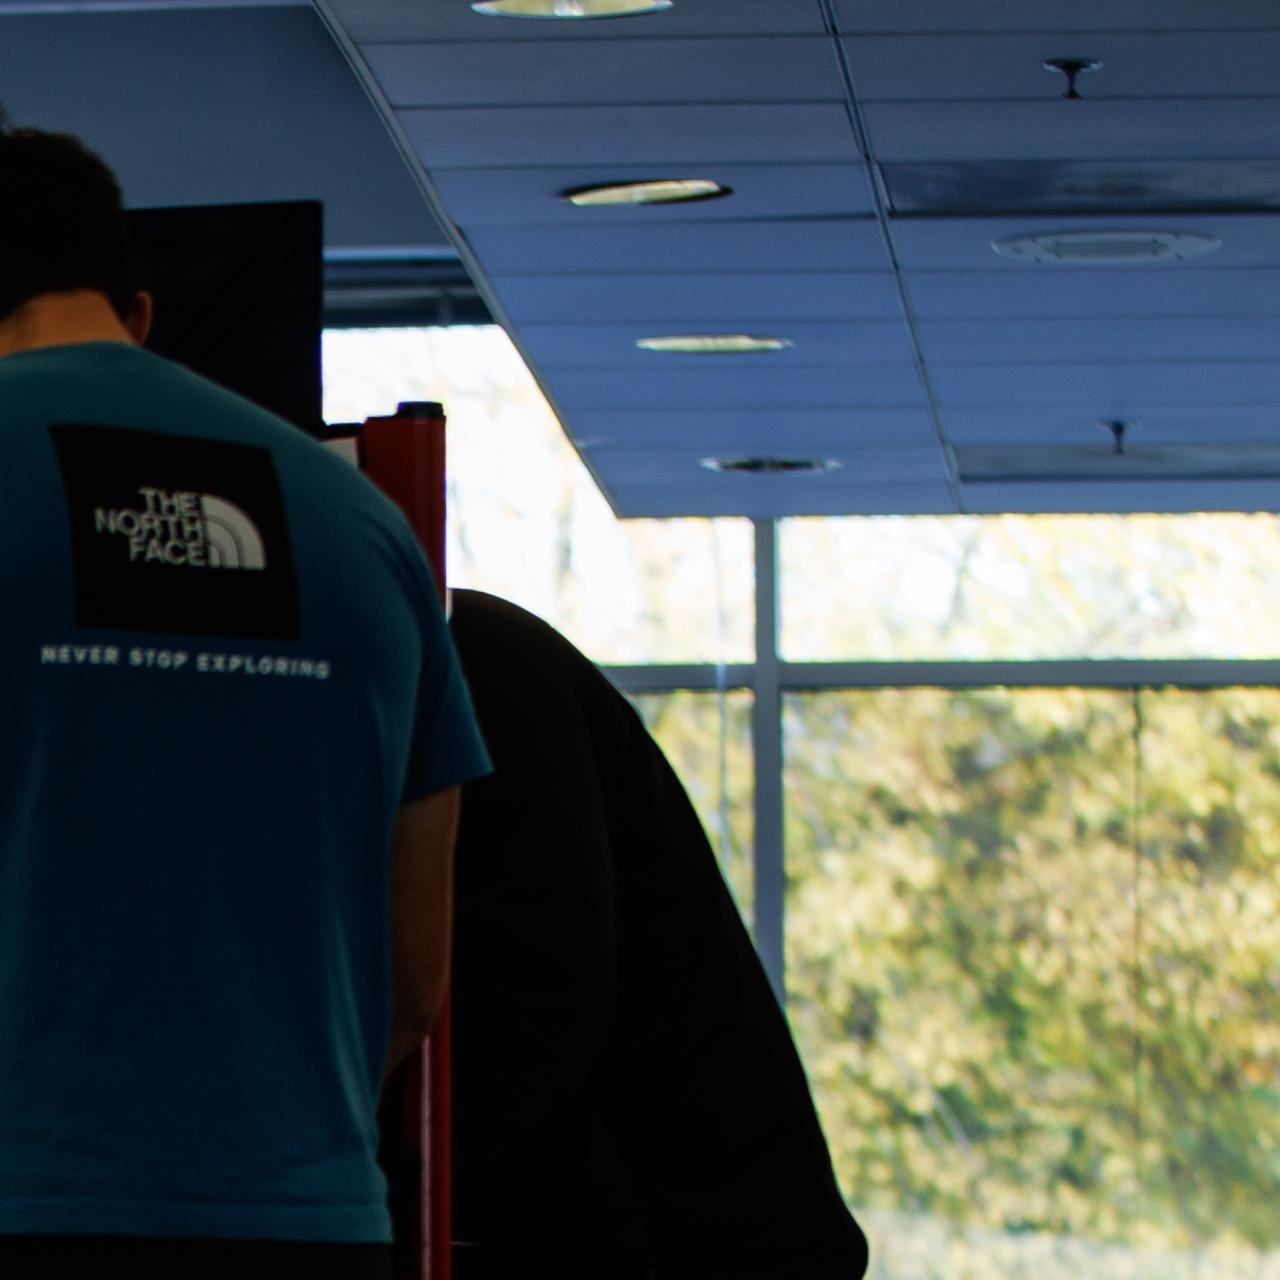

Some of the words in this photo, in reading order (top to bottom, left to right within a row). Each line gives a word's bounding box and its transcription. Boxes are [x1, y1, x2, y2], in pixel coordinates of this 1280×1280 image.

[136, 486, 200, 516] THE
[94, 506, 204, 541] NORTH
[128, 536, 208, 567] FACE
[40, 644, 121, 666] NEVER
[128, 646, 188, 670] STOP
[196, 652, 330, 680] EXPLORING
